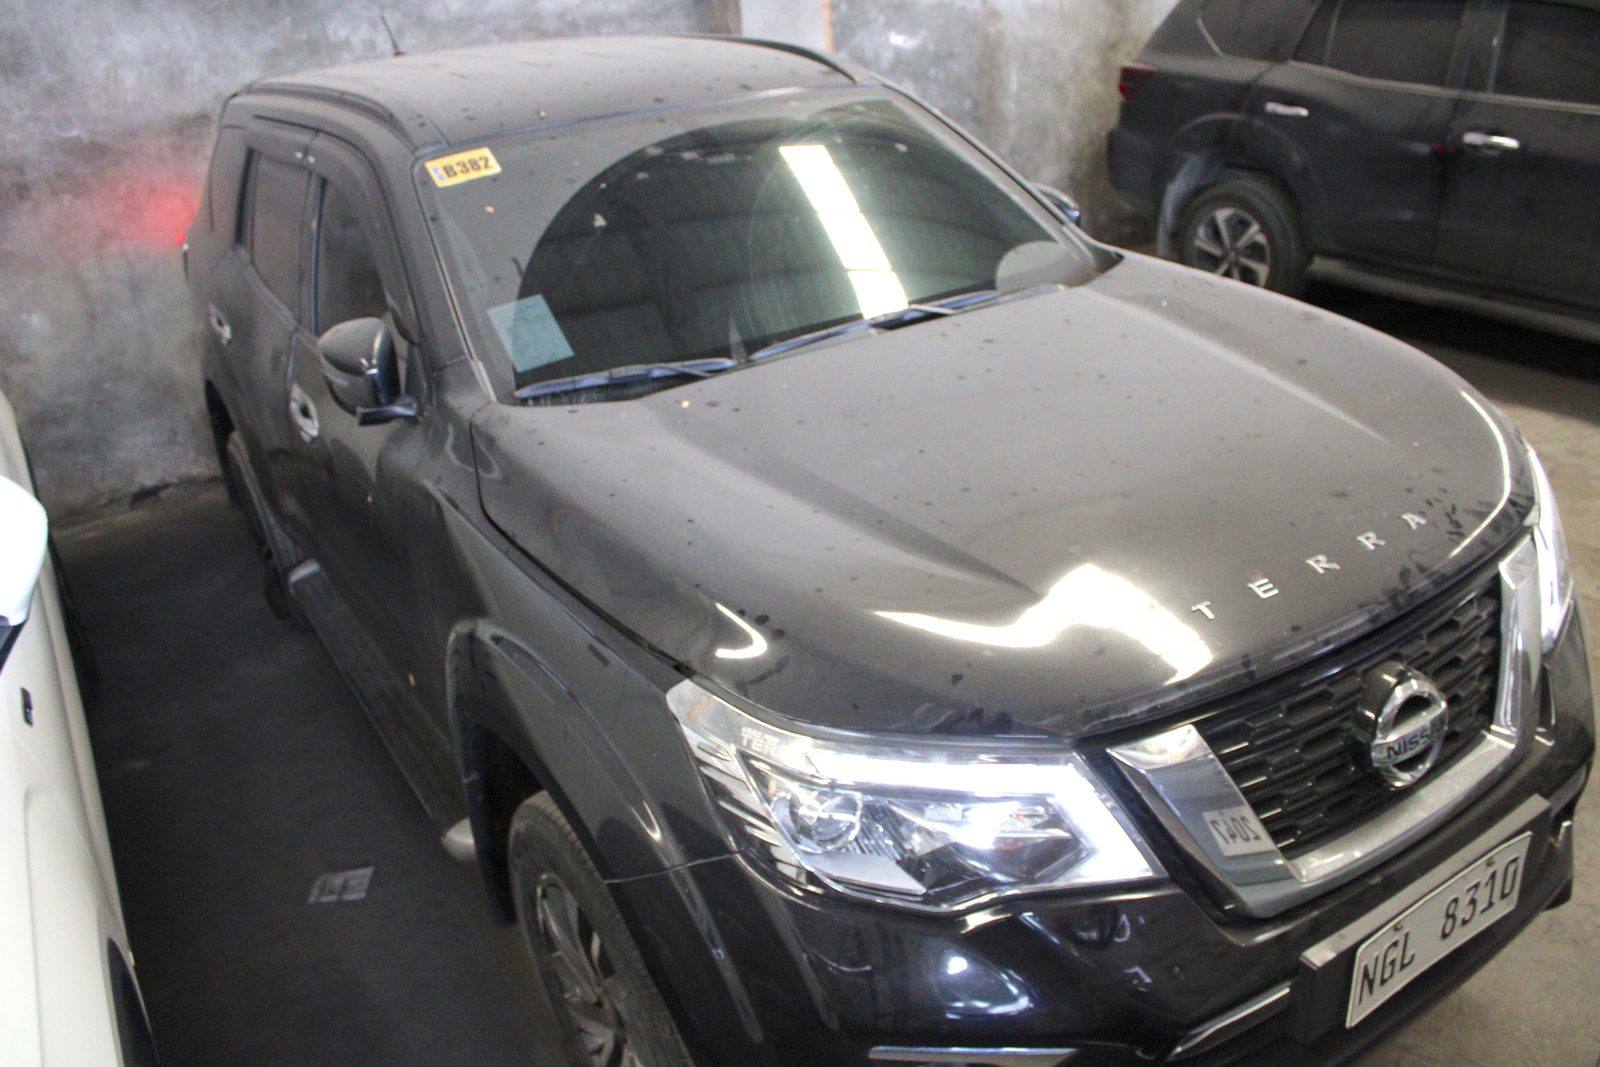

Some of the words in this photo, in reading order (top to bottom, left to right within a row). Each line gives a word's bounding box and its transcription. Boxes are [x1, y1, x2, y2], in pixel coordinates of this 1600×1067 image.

[443, 156, 493, 178] B382
[1191, 513, 1427, 620] TERRA
[1358, 931, 1416, 1005] NGL
[1440, 856, 1519, 940] 8310
